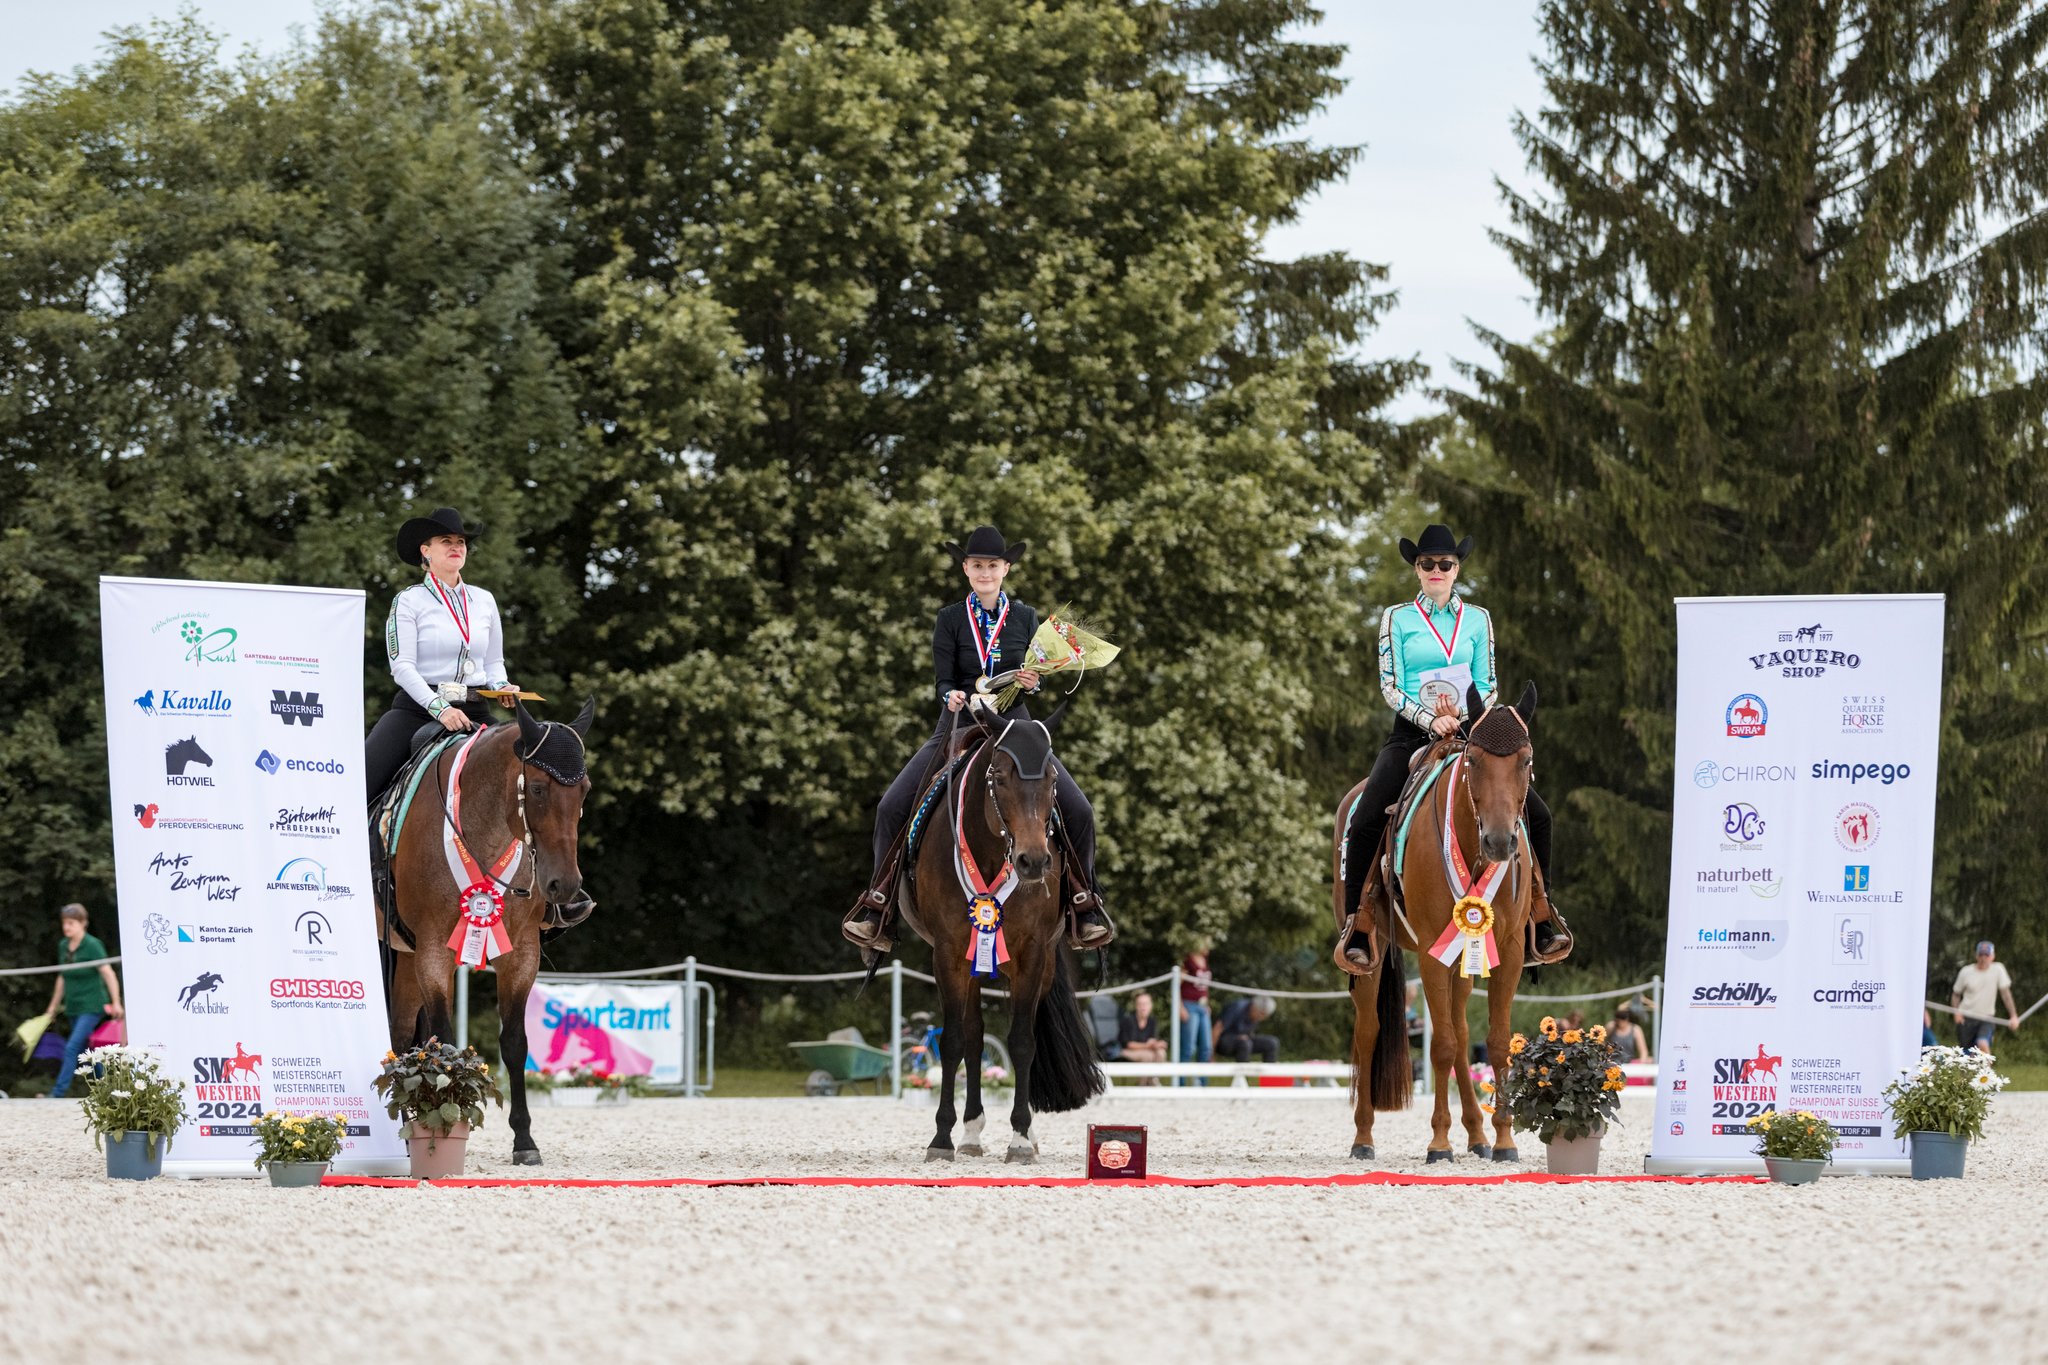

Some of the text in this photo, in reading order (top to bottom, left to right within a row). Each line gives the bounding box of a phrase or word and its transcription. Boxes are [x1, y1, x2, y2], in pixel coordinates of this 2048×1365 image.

[185, 627, 238, 663] Rust
[278, 655, 319, 663] GARTENPFLEGE
[1749, 648, 1861, 670] VAQUERO
[1782, 666, 1825, 678] SHOP
[160, 689, 232, 711] Kavallo
[1842, 696, 1885, 704] SWISS
[272, 703, 323, 715] WESTERNER
[1842, 705, 1885, 714] QUARTER
[286, 758, 344, 774] encodo
[1811, 758, 1911, 785] simpego
[1722, 765, 1796, 781] CHIRON
[166, 776, 215, 787] HOTWIEL
[158, 822, 244, 830] PFERDEVERSICHERUNG
[269, 823, 341, 835] PFERDEPENSION
[148, 851, 193, 875] Auto
[170, 871, 230, 891] Zentrum
[1696, 867, 1773, 882] naturbett
[207, 884, 242, 902] West
[266, 882, 351, 894] ALPINE WESTERN HORSES
[1696, 885, 1738, 893] lit naturel
[199, 935, 236, 943] Sportamt
[1698, 928, 1775, 942] feldmann.
[270, 978, 365, 1000] SWISSLOS
[1851, 979, 1886, 994] design
[1692, 982, 1772, 1006] schölly
[1813, 989, 1874, 1003] carma
[191, 993, 229, 1014] felix bühler
[270, 1000, 367, 1010] Sportfonds Kanton Zürich
[542, 999, 671, 1035] Sportamt
[271, 1057, 322, 1067] SCHWEIZER
[1791, 1058, 1841, 1068] SCHWEIZER
[193, 1057, 232, 1084] SM
[272, 1070, 342, 1080] MEISTERSCHAFT
[1713, 1058, 1750, 1084] SM
[1790, 1071, 1861, 1081] MEISTERSCHAFT
[195, 1085, 261, 1101] WESTERN
[273, 1083, 345, 1093] WESTERNREITEN
[1713, 1085, 1777, 1101] WESTERN
[1790, 1084, 1862, 1094] WESTERNREITEN
[274, 1096, 364, 1106] CHAMPIONAT SUISSE
[1789, 1097, 1879, 1107] CHAMPIONAT SUISSE
[197, 1102, 264, 1119] 2024
[1841, 1110, 1883, 1120] WESTERN
[236, 1127, 250, 1135] JULI
